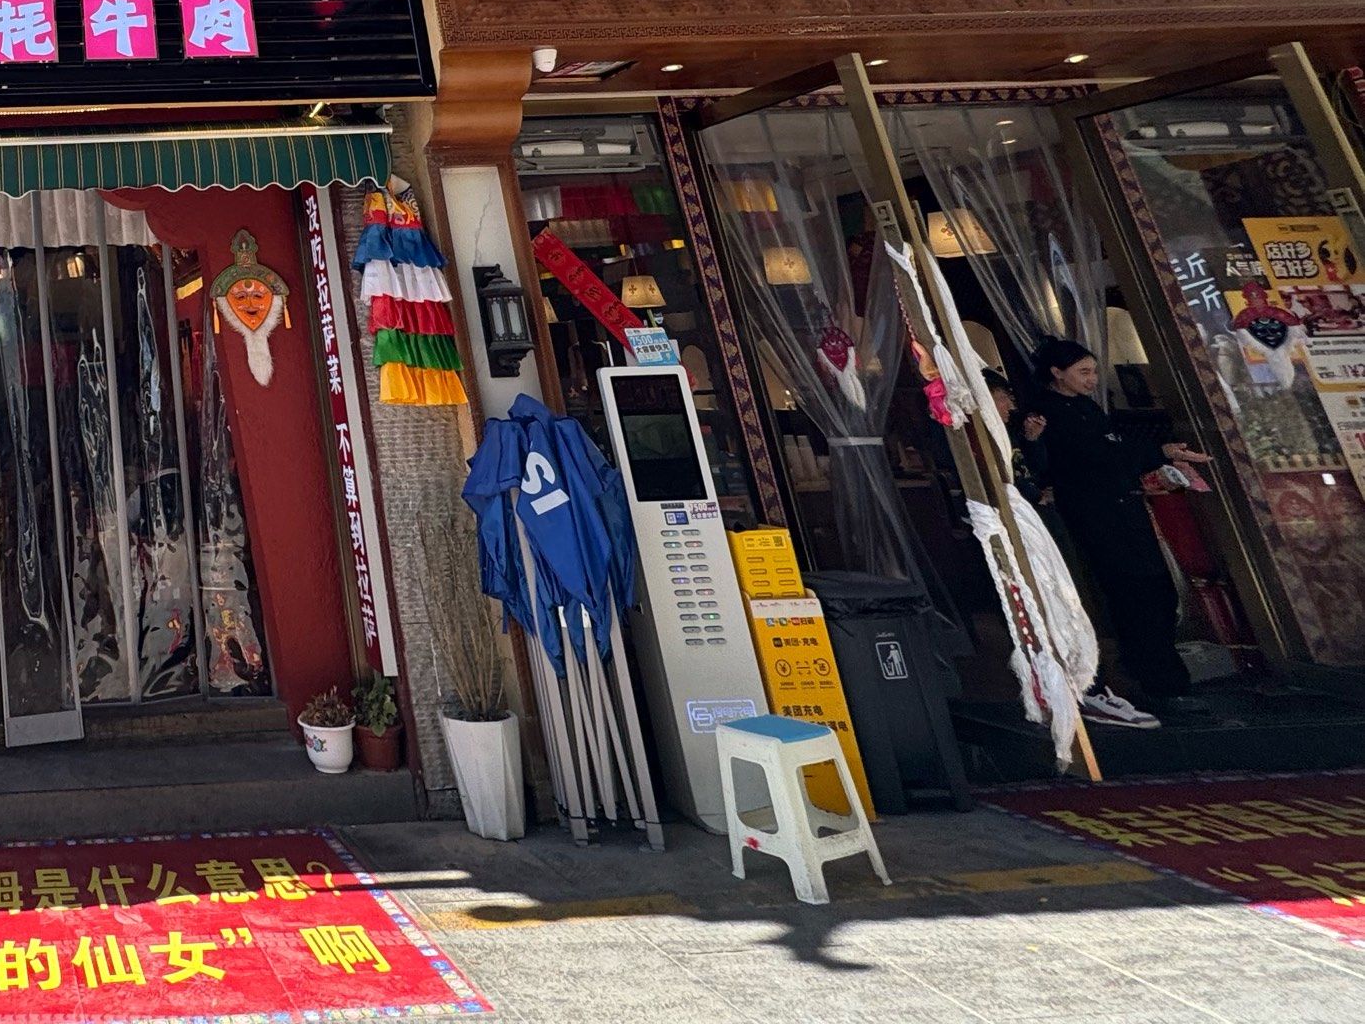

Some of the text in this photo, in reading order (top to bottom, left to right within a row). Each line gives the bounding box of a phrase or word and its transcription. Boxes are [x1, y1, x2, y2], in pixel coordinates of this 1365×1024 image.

[1264, 241, 1311, 260] 店好多
[1271, 260, 1320, 278] 省好多
[305, 195, 342, 395] 没吃拉萨菜
[299, 924, 390, 975] 啊
